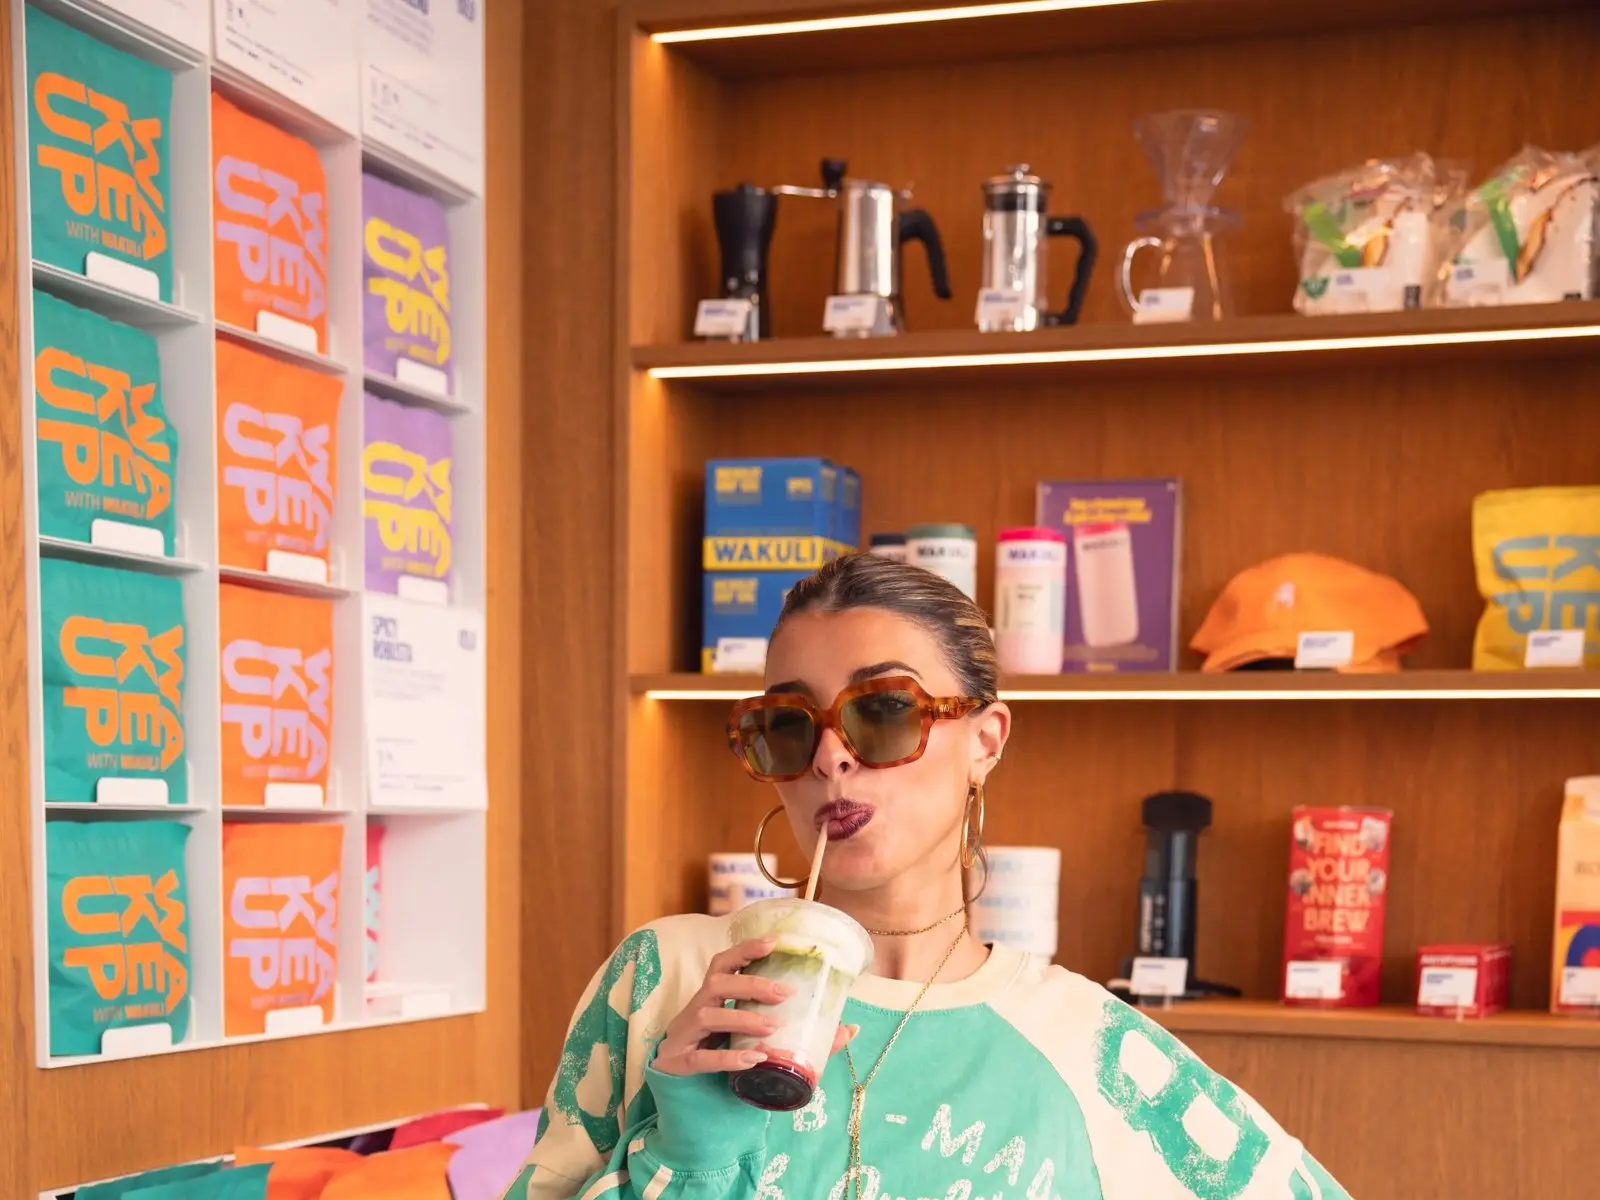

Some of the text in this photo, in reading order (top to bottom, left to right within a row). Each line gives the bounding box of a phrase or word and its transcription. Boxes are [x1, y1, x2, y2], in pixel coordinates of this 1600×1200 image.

[34, 72, 96, 215] UP
[87, 88, 141, 232] KE
[215, 155, 269, 283] UP
[35, 346, 99, 485] UP
[86, 361, 145, 493] KE
[223, 402, 277, 525] UP
[64, 490, 100, 511] WITH
[714, 542, 817, 563] WAKULI
[59, 615, 118, 746] UP
[106, 622, 160, 746] KE
[222, 639, 272, 758] UP
[1303, 908, 1370, 932] BREW
[1308, 858, 1369, 881] YOUR
[61, 875, 127, 1000] UP
[111, 874, 165, 995] KE
[229, 876, 281, 989] UP
